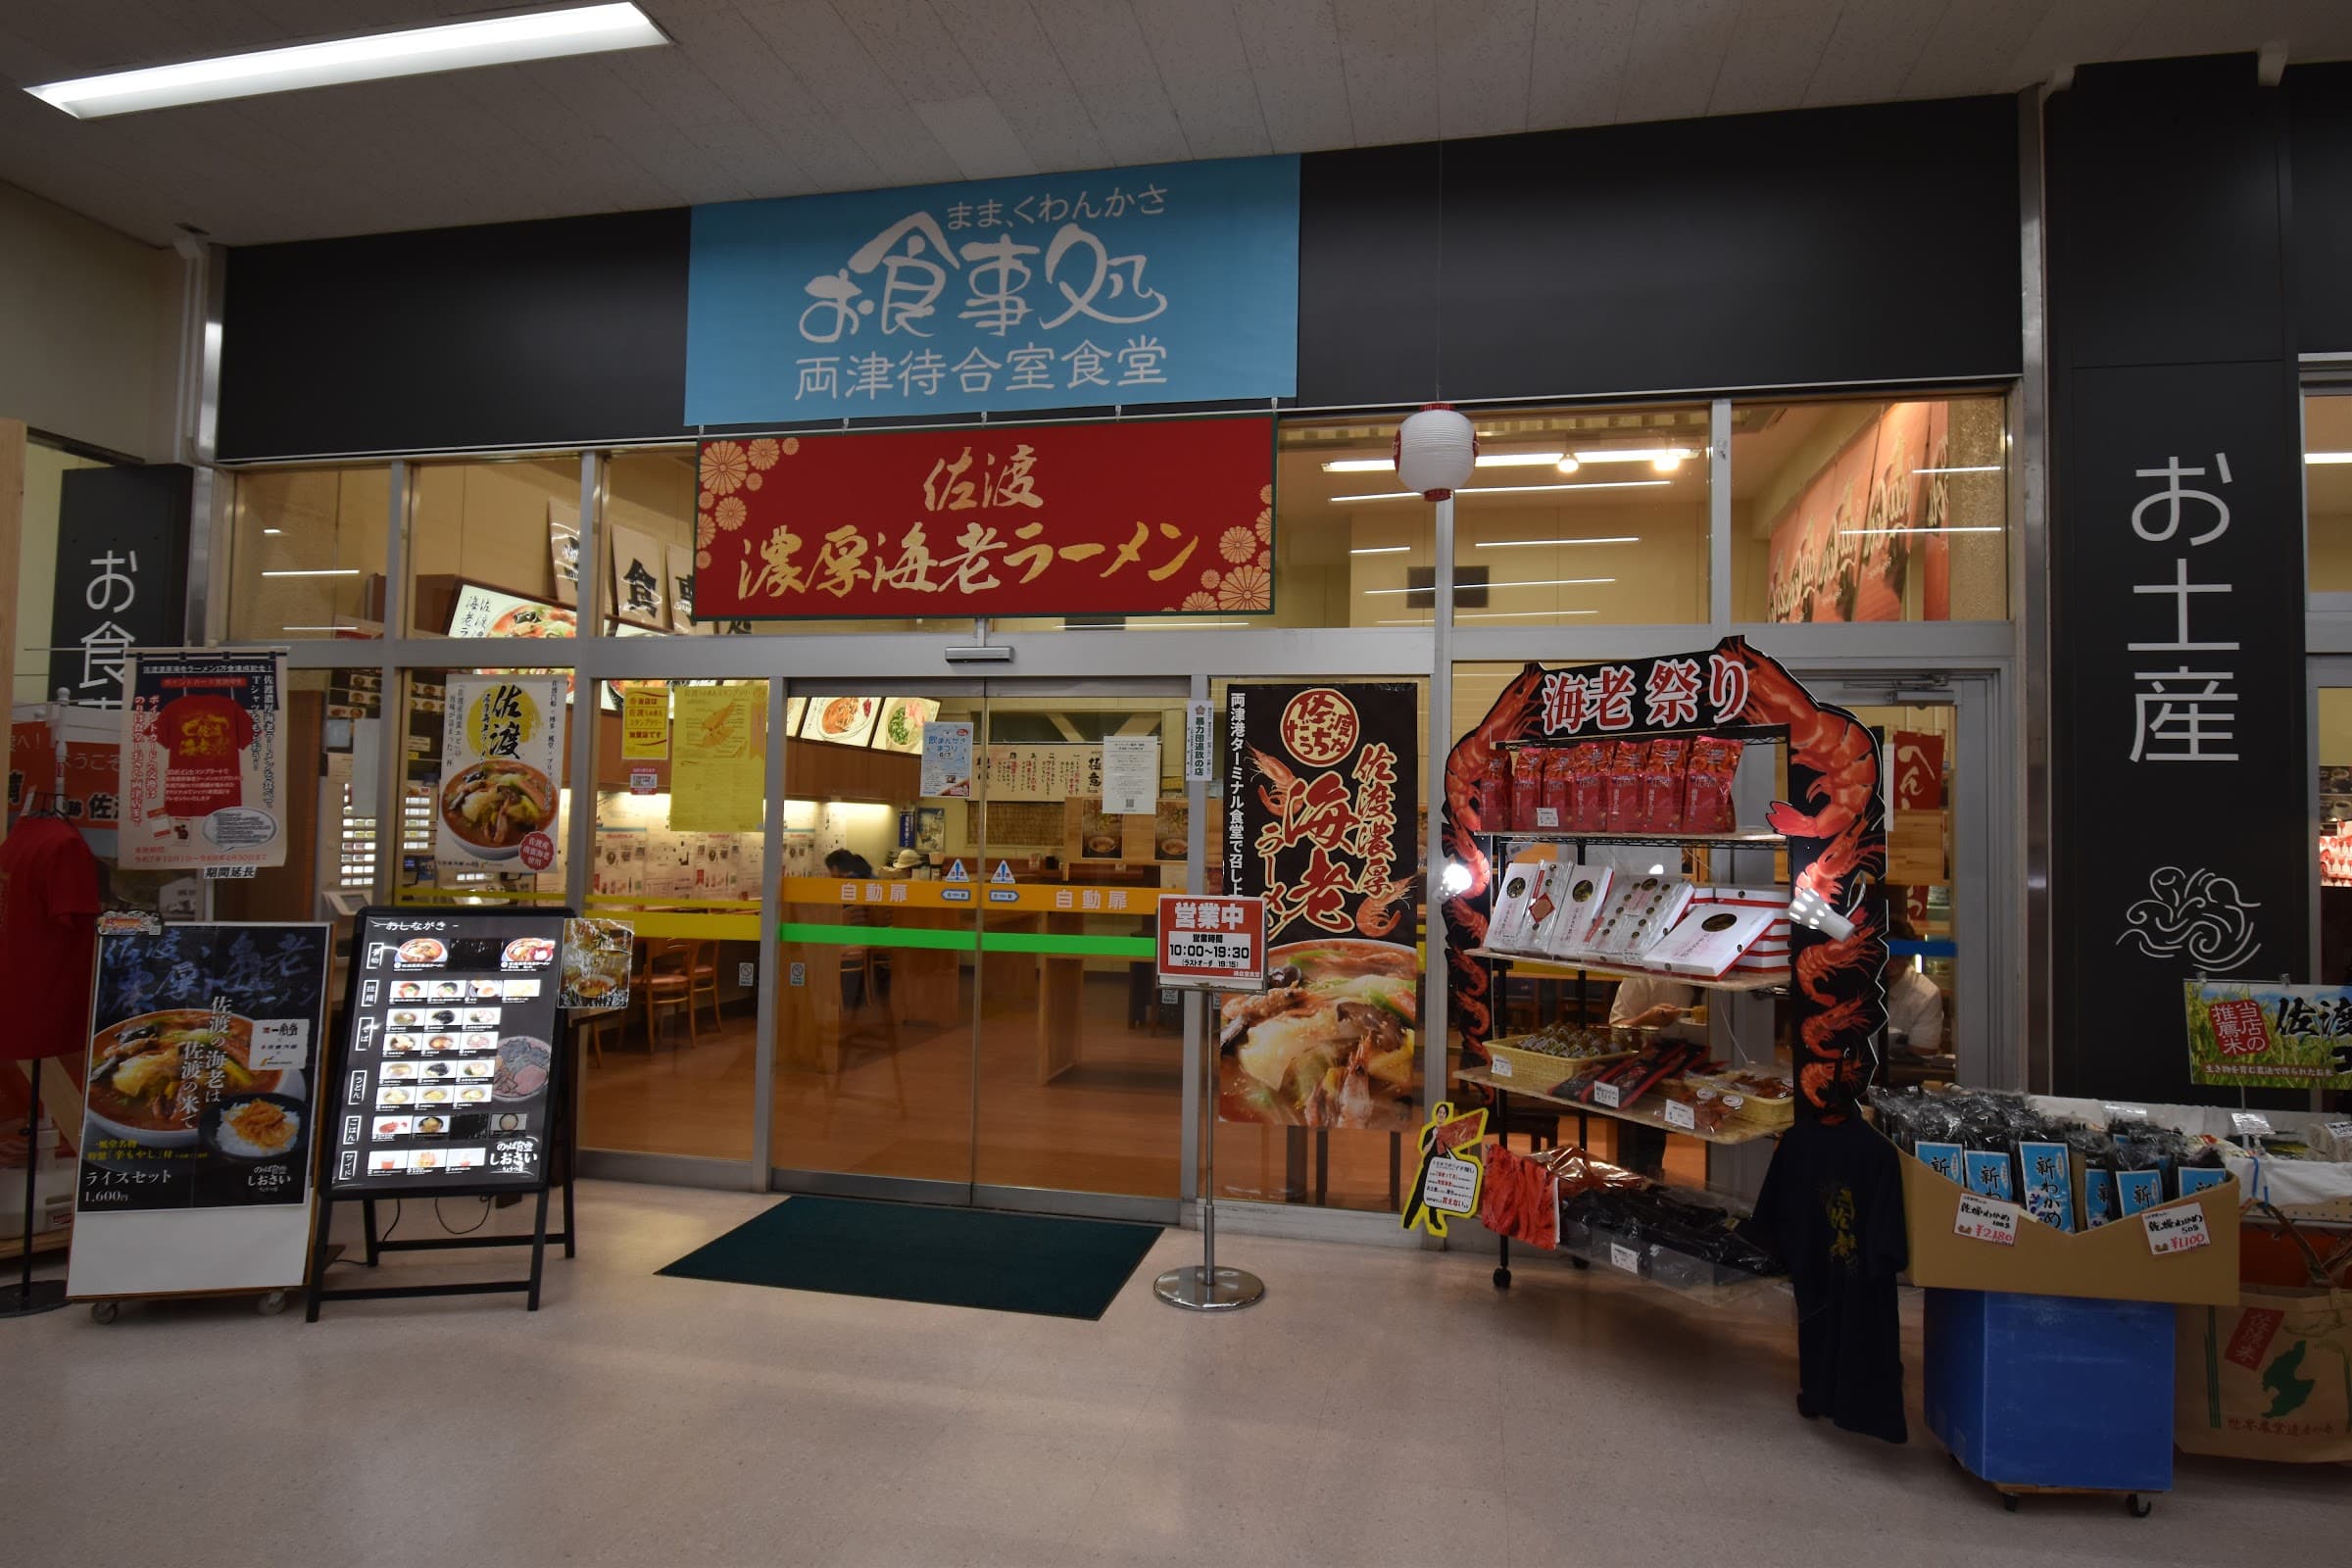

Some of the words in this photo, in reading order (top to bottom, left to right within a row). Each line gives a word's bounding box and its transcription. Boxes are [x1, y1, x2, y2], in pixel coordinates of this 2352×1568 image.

[799, 211, 1167, 343] お食事処
[795, 334, 1168, 401] 両津待合室食堂
[922, 444, 1044, 512] 佐渡
[737, 520, 1200, 600] 濃厚海老ラーメン
[79, 550, 139, 710] お食
[2128, 452, 2240, 763] お土産
[492, 684, 526, 760] 佐渡
[1542, 655, 1749, 735] 海老祭り
[1283, 770, 1361, 933] 海老
[1352, 743, 1397, 899] 佐渡濃厚
[206, 867, 255, 878] 期間延長
[841, 883, 907, 903] 自動扉
[1054, 890, 1128, 911] 自動扉
[385, 919, 447, 932] おしながき
[1174, 902, 1245, 931] 営業中
[1193, 934, 1223, 943] 営業時間
[204, 995, 233, 1103] 佐渡の海老は
[2236, 1001, 2267, 1052] 当店の
[179, 1040, 204, 1128] 佐渡の米で
[84, 1169, 172, 1187] ライスセット
[248, 1174, 291, 1187] しおさい
[490, 1152, 538, 1165] しおさい
[2035, 1156, 2062, 1229] 新わかめ
